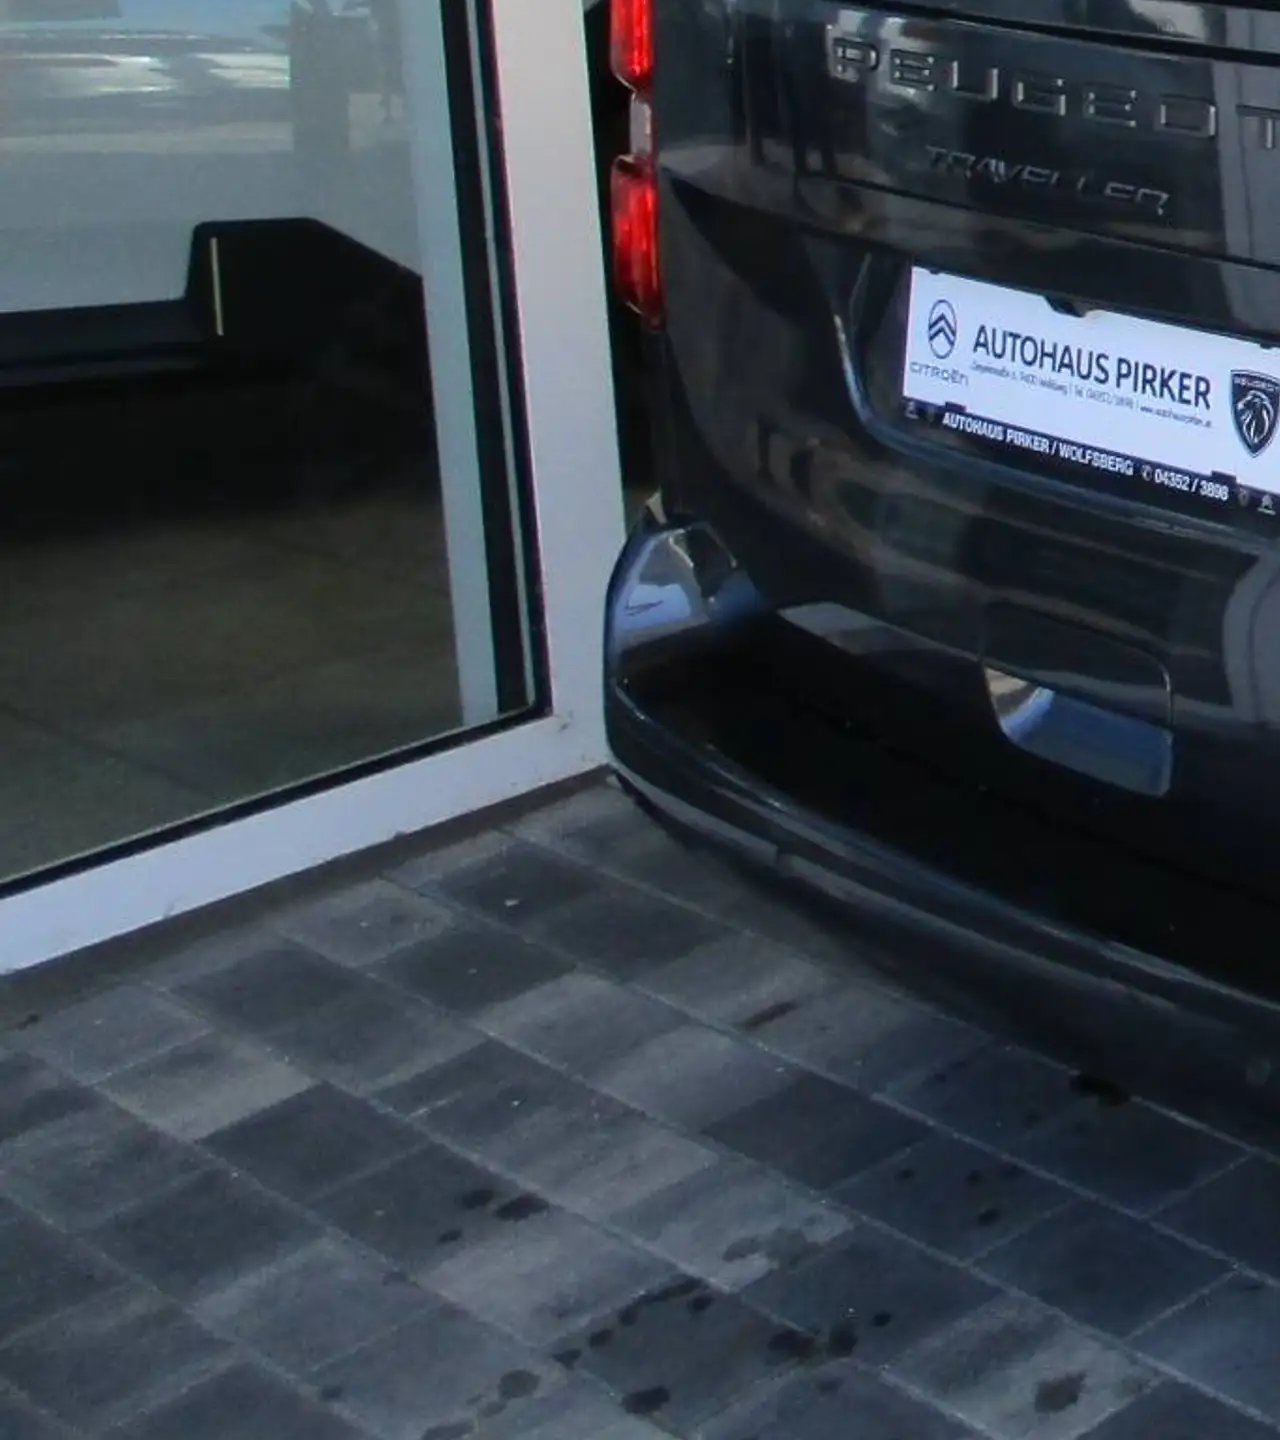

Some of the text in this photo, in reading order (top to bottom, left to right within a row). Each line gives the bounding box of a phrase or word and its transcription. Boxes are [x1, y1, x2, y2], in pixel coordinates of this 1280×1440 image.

[924, 143, 1173, 218] TRAVELLER
[973, 324, 1110, 387] AUTOHAUS
[1114, 357, 1212, 411] PIRKER
[942, 412, 1004, 441] AUTOHAUS
[1006, 428, 1050, 455] PIRKER
[1051, 440, 1058, 456] /
[1058, 441, 1134, 476] WOLFSBERG
[1154, 468, 1191, 493] 04352
